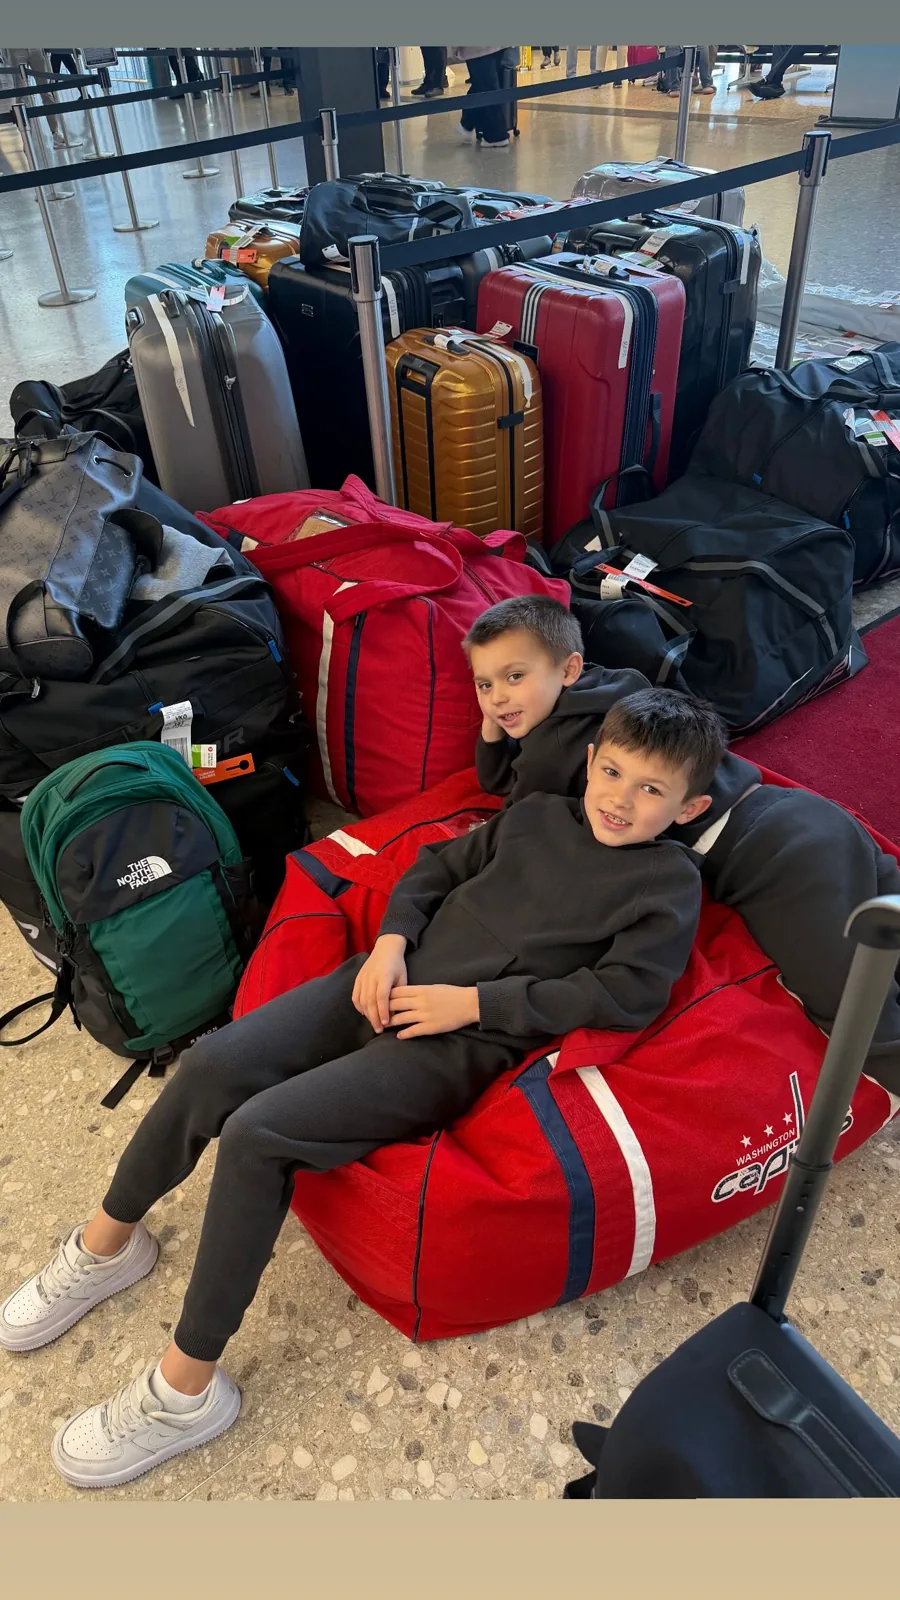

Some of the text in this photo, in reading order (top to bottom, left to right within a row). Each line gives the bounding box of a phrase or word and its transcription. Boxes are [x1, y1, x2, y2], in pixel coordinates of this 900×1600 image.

[127, 858, 149, 872] THE
[116, 865, 152, 887] NORTH
[129, 872, 156, 890] FACE
[735, 1127, 796, 1168] WASHINGTON
